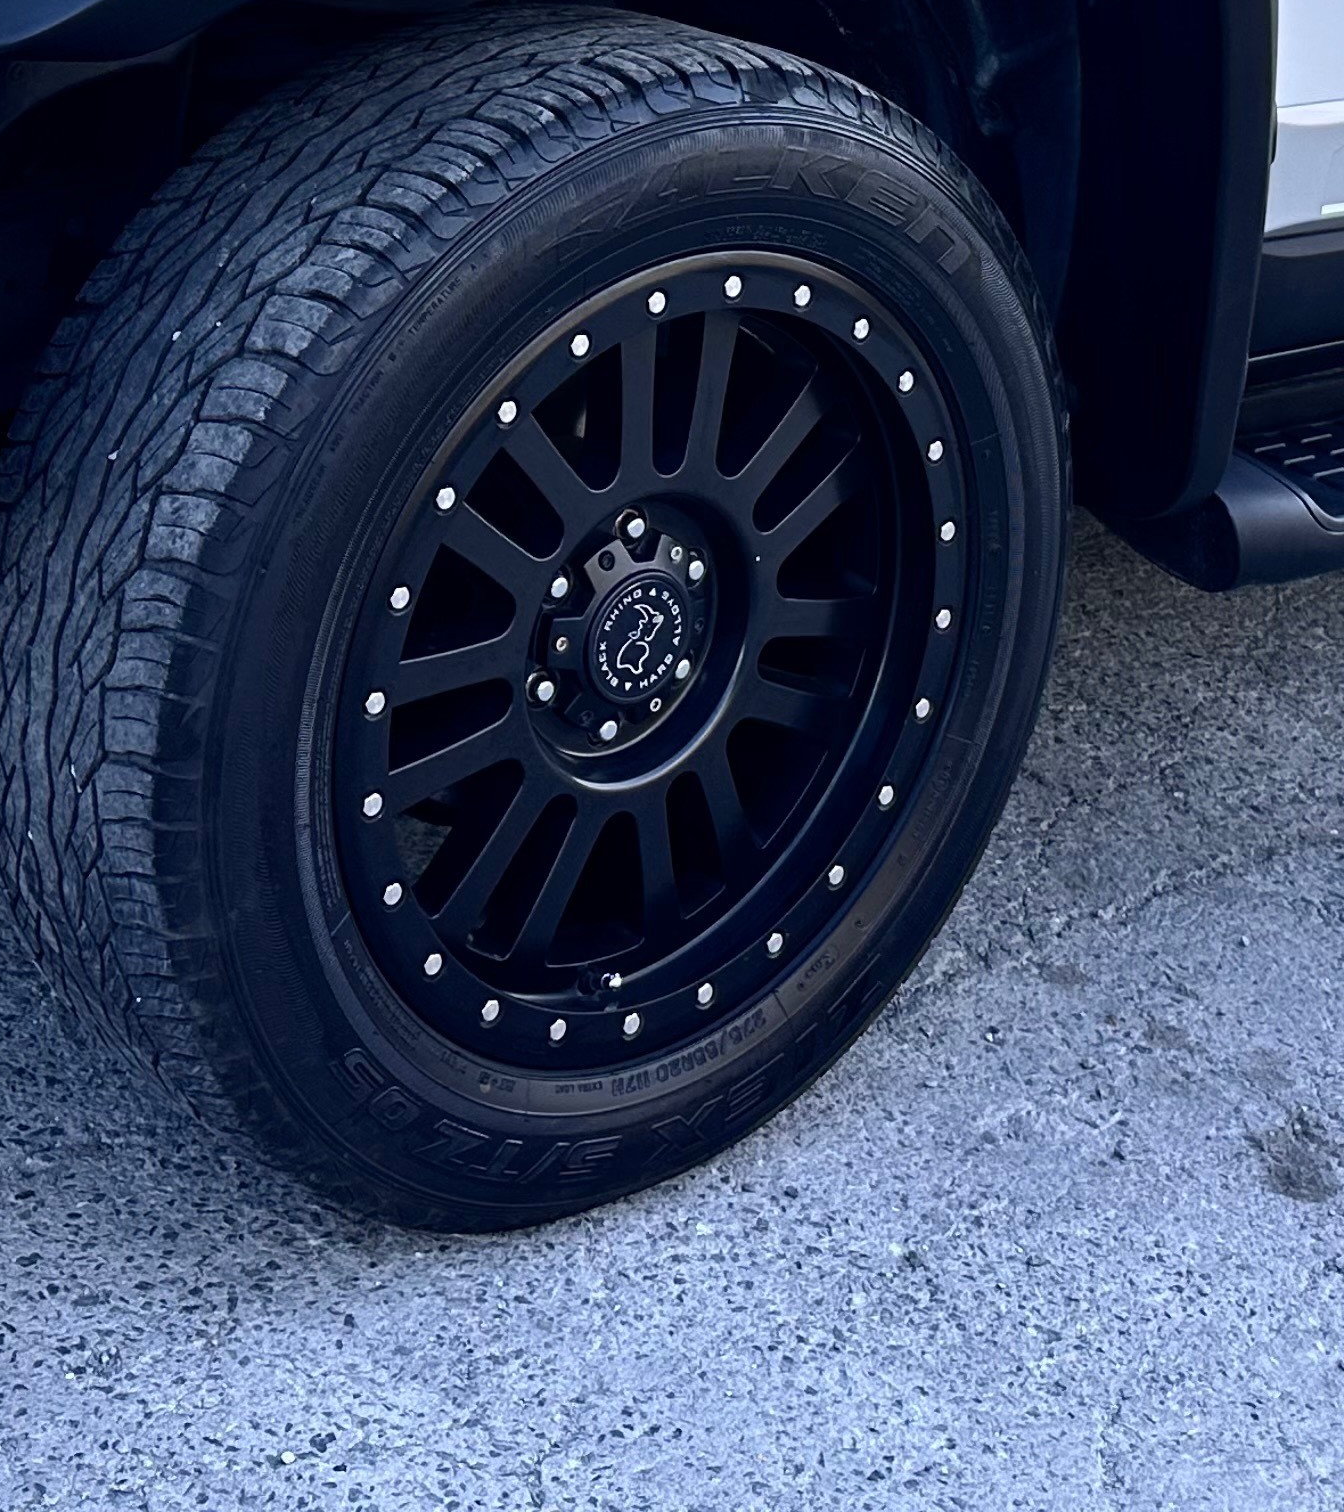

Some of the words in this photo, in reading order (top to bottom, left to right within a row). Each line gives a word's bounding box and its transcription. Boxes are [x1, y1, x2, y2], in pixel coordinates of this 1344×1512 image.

[530, 145, 974, 276] FALKEN
[603, 588, 643, 631] RHINO
[639, 653, 674, 689] HARD
[661, 590, 682, 646] ALLOYS
[599, 641, 619, 687] BLACK
